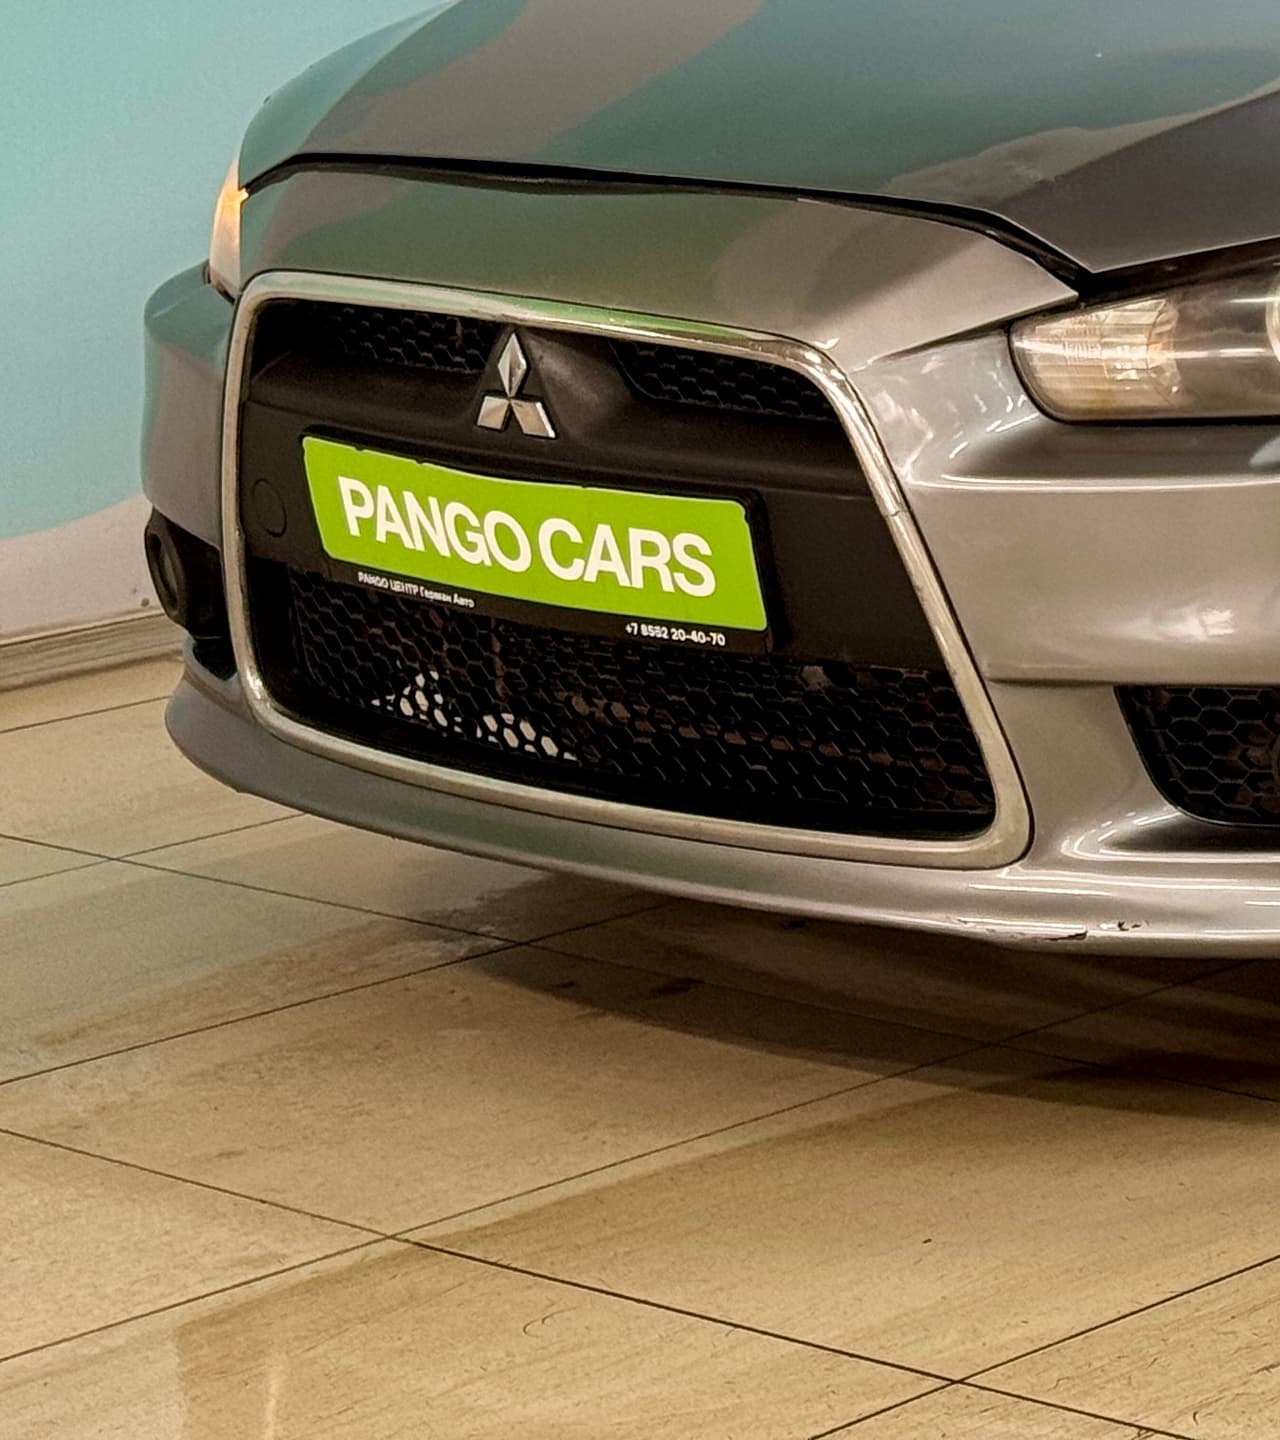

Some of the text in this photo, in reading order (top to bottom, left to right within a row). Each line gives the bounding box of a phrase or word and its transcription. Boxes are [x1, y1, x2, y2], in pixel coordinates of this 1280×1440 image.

[338, 475, 716, 598] PANGO CARS
[625, 622, 639, 636] +7
[670, 628, 726, 646] 20-40-70
